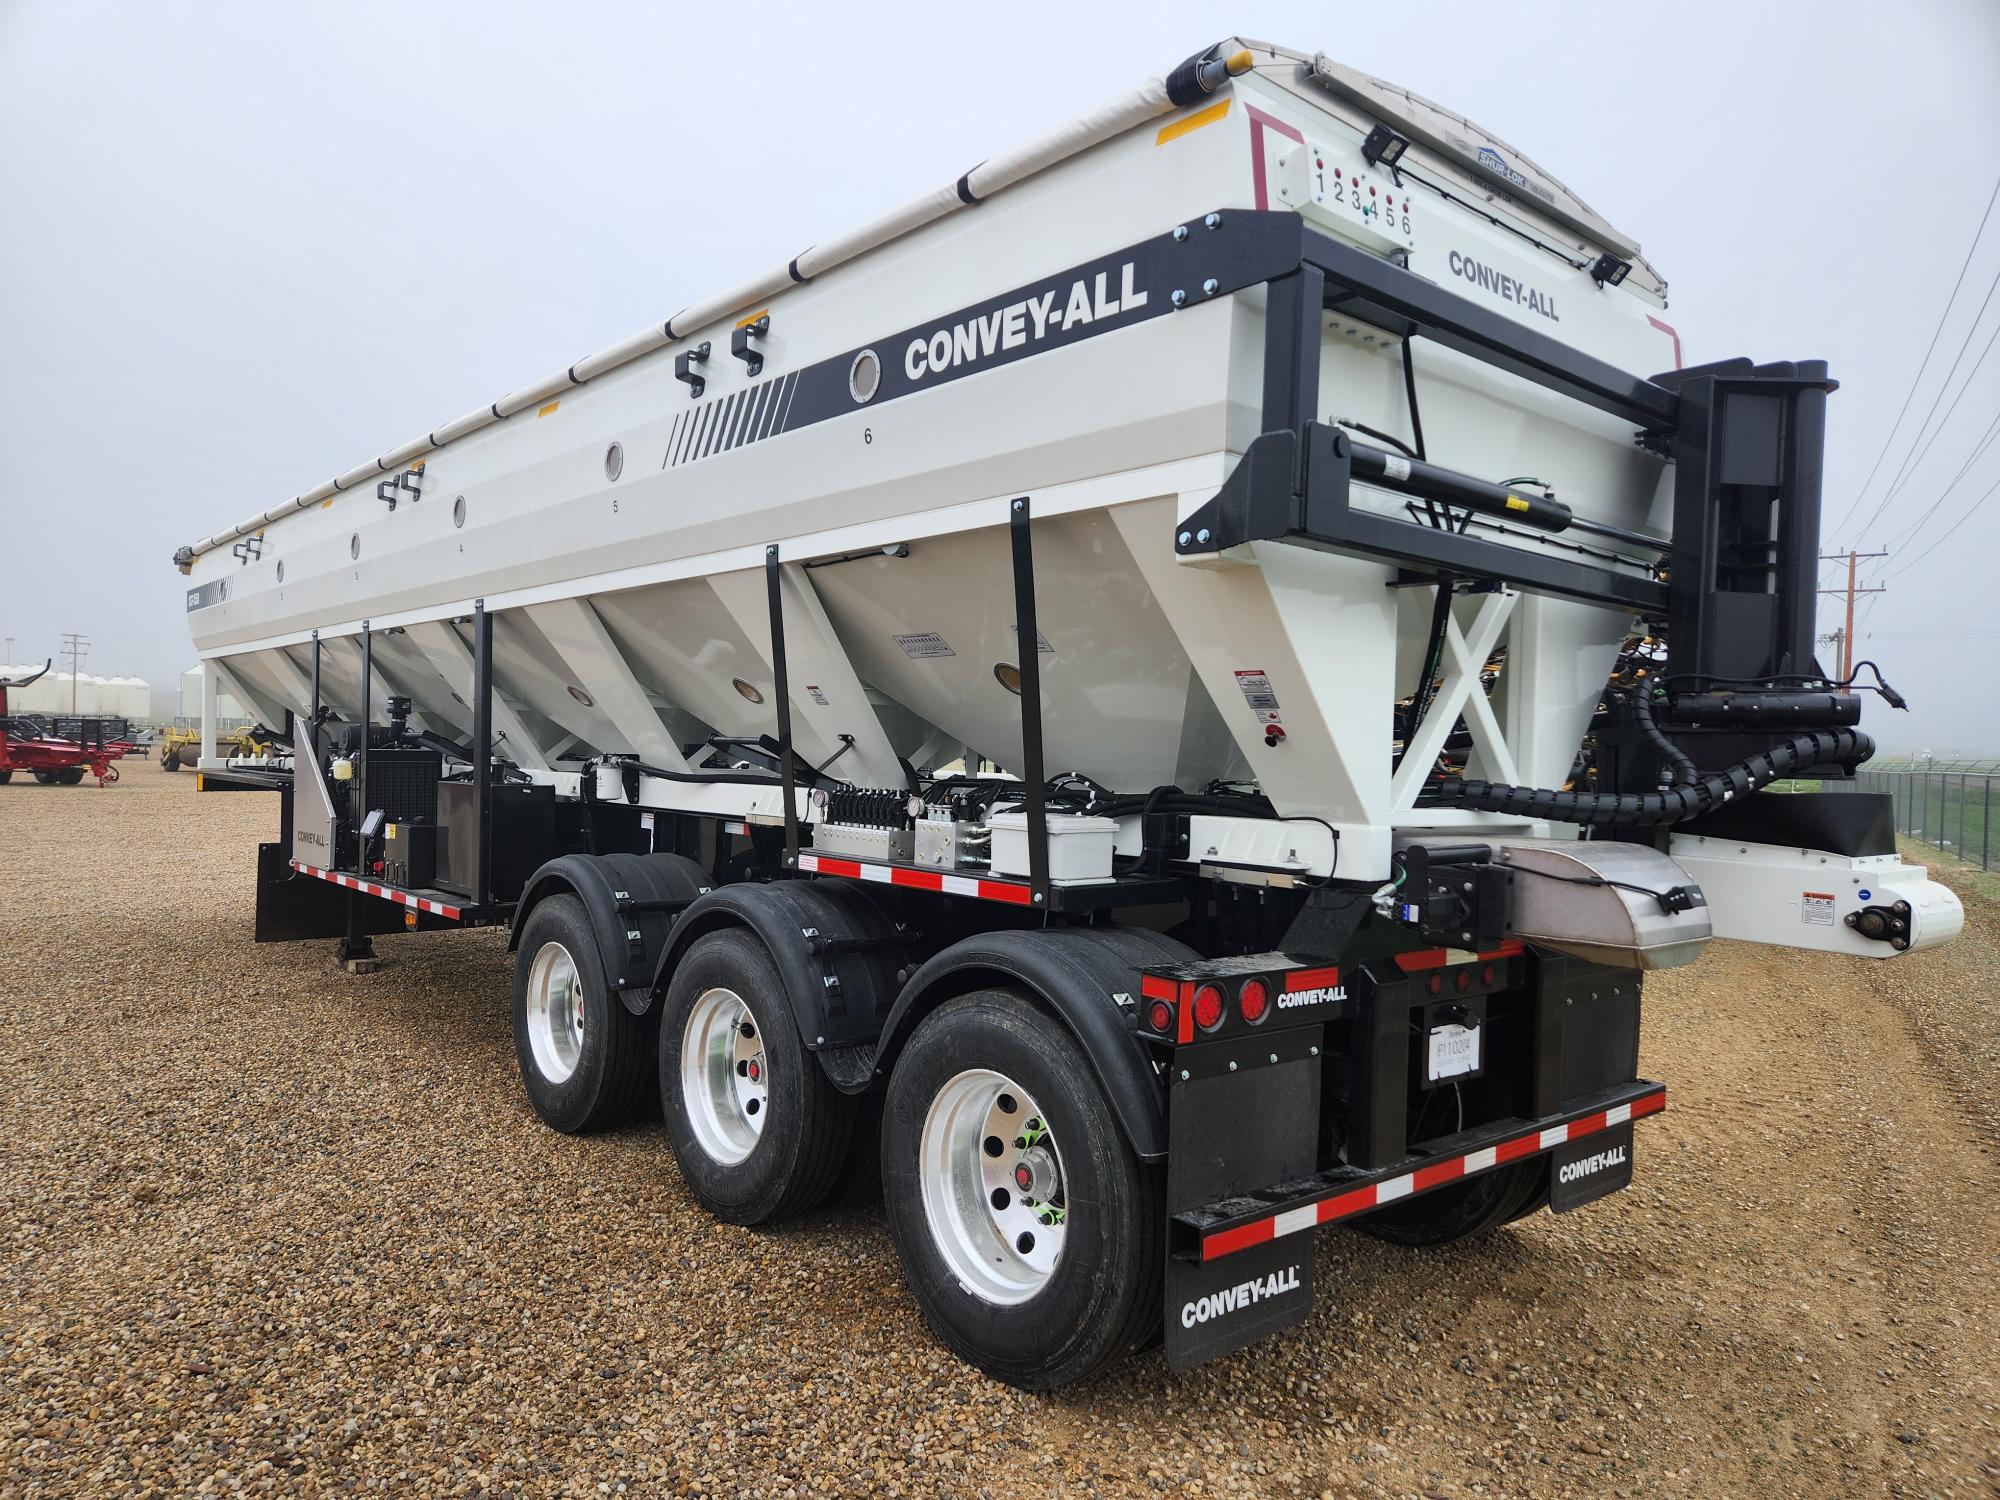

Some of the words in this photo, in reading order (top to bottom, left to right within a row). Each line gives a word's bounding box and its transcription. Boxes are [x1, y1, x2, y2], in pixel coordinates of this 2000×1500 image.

[1316, 173, 1324, 193] 1
[1334, 182, 1344, 203] 2
[1352, 191, 1361, 210] 3
[1369, 200, 1378, 220] 4
[1386, 208, 1395, 227] 5
[1402, 216, 1411, 235] 6
[1448, 250, 1560, 322] CONVEY-ALL
[905, 262, 1148, 380] CONVEY-ALL
[864, 428, 873, 445] 6
[612, 500, 619, 513] 5
[297, 830, 325, 847] CONVEY-ALL
[1277, 986, 1348, 1009] CONVEY-ALL
[1560, 1146, 1626, 1184] CONVEY-ALL
[1181, 1266, 1300, 1329] CONVEY-ALL
